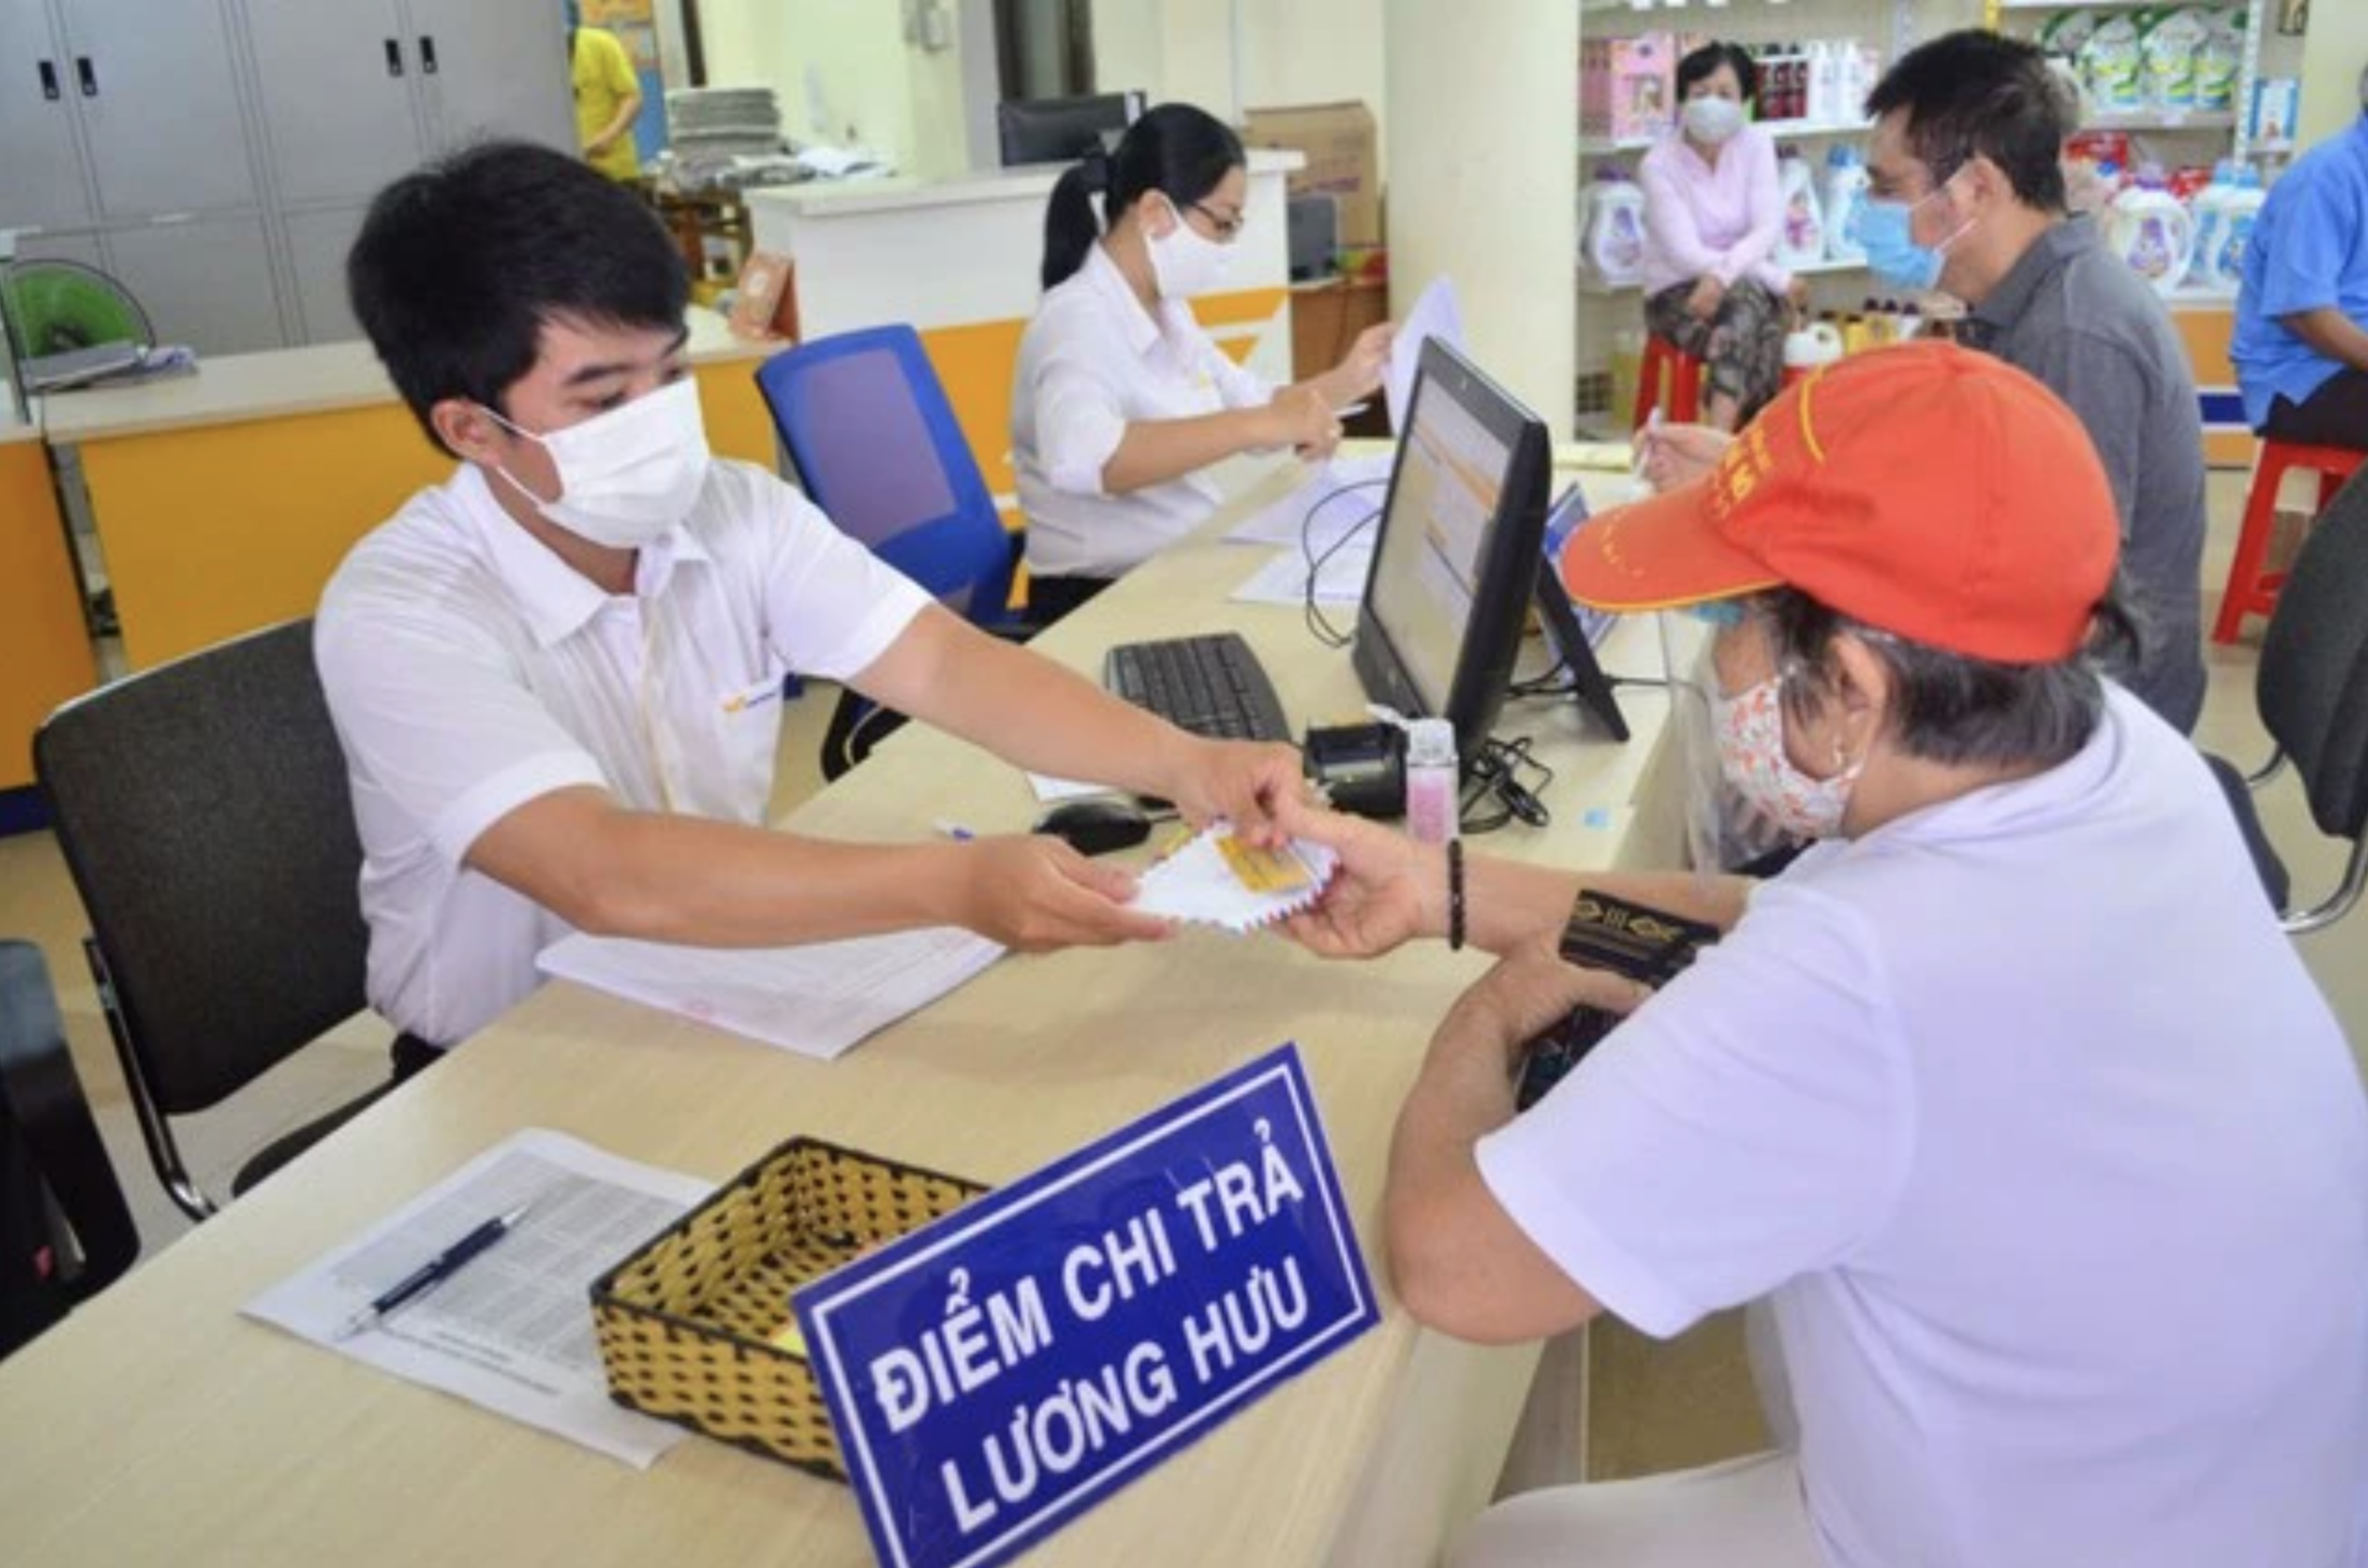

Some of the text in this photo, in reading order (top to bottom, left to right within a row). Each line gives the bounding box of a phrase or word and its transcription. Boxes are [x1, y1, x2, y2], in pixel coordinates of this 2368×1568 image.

[870, 1117, 1304, 1433] ĐIỂM CHI TRẢ
[942, 1256, 1307, 1533] LƯƠNG HƯU
